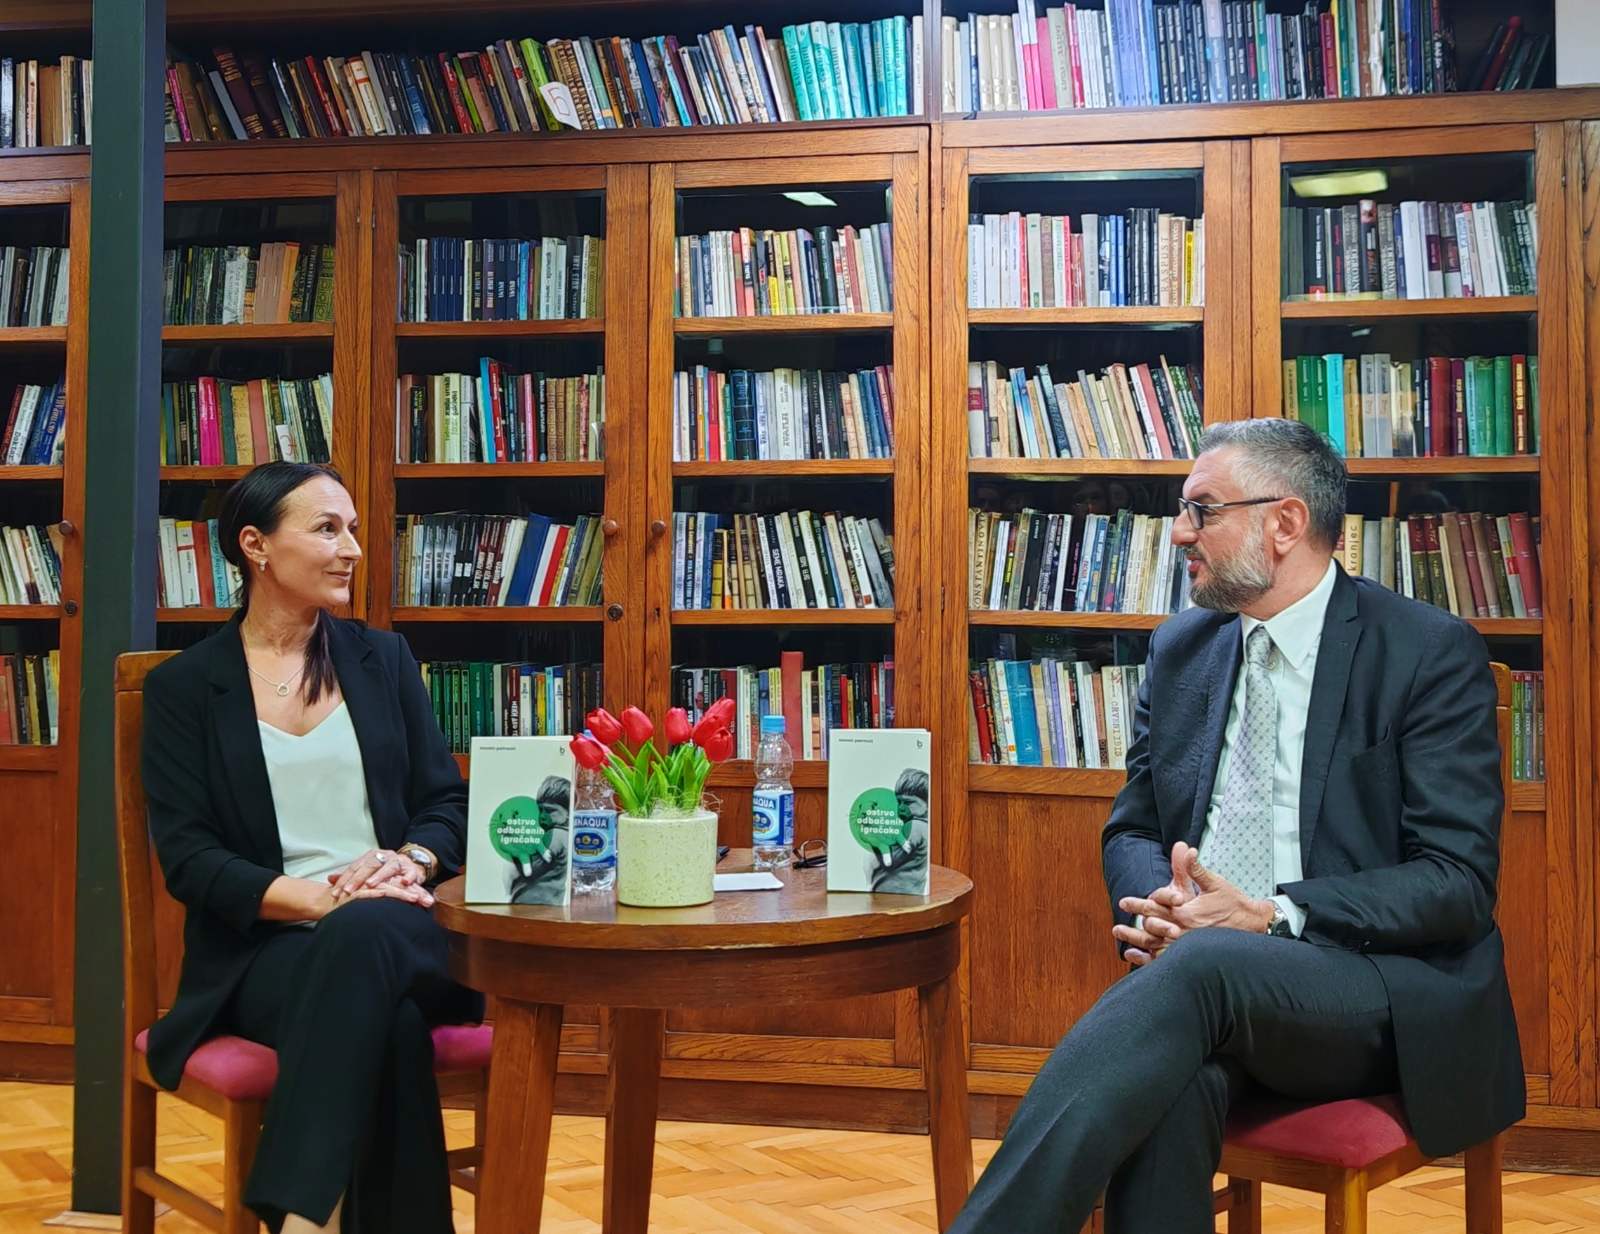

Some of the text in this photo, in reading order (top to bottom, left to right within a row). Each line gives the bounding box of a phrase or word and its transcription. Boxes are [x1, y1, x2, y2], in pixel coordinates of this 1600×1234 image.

[866, 809, 895, 817] ostrvo
[507, 818, 536, 826] ostrvo
[857, 817, 904, 826] odbačenih
[497, 826, 545, 835] odbačenih
[860, 826, 900, 835] igračaka
[500, 835, 541, 845] igračaka
